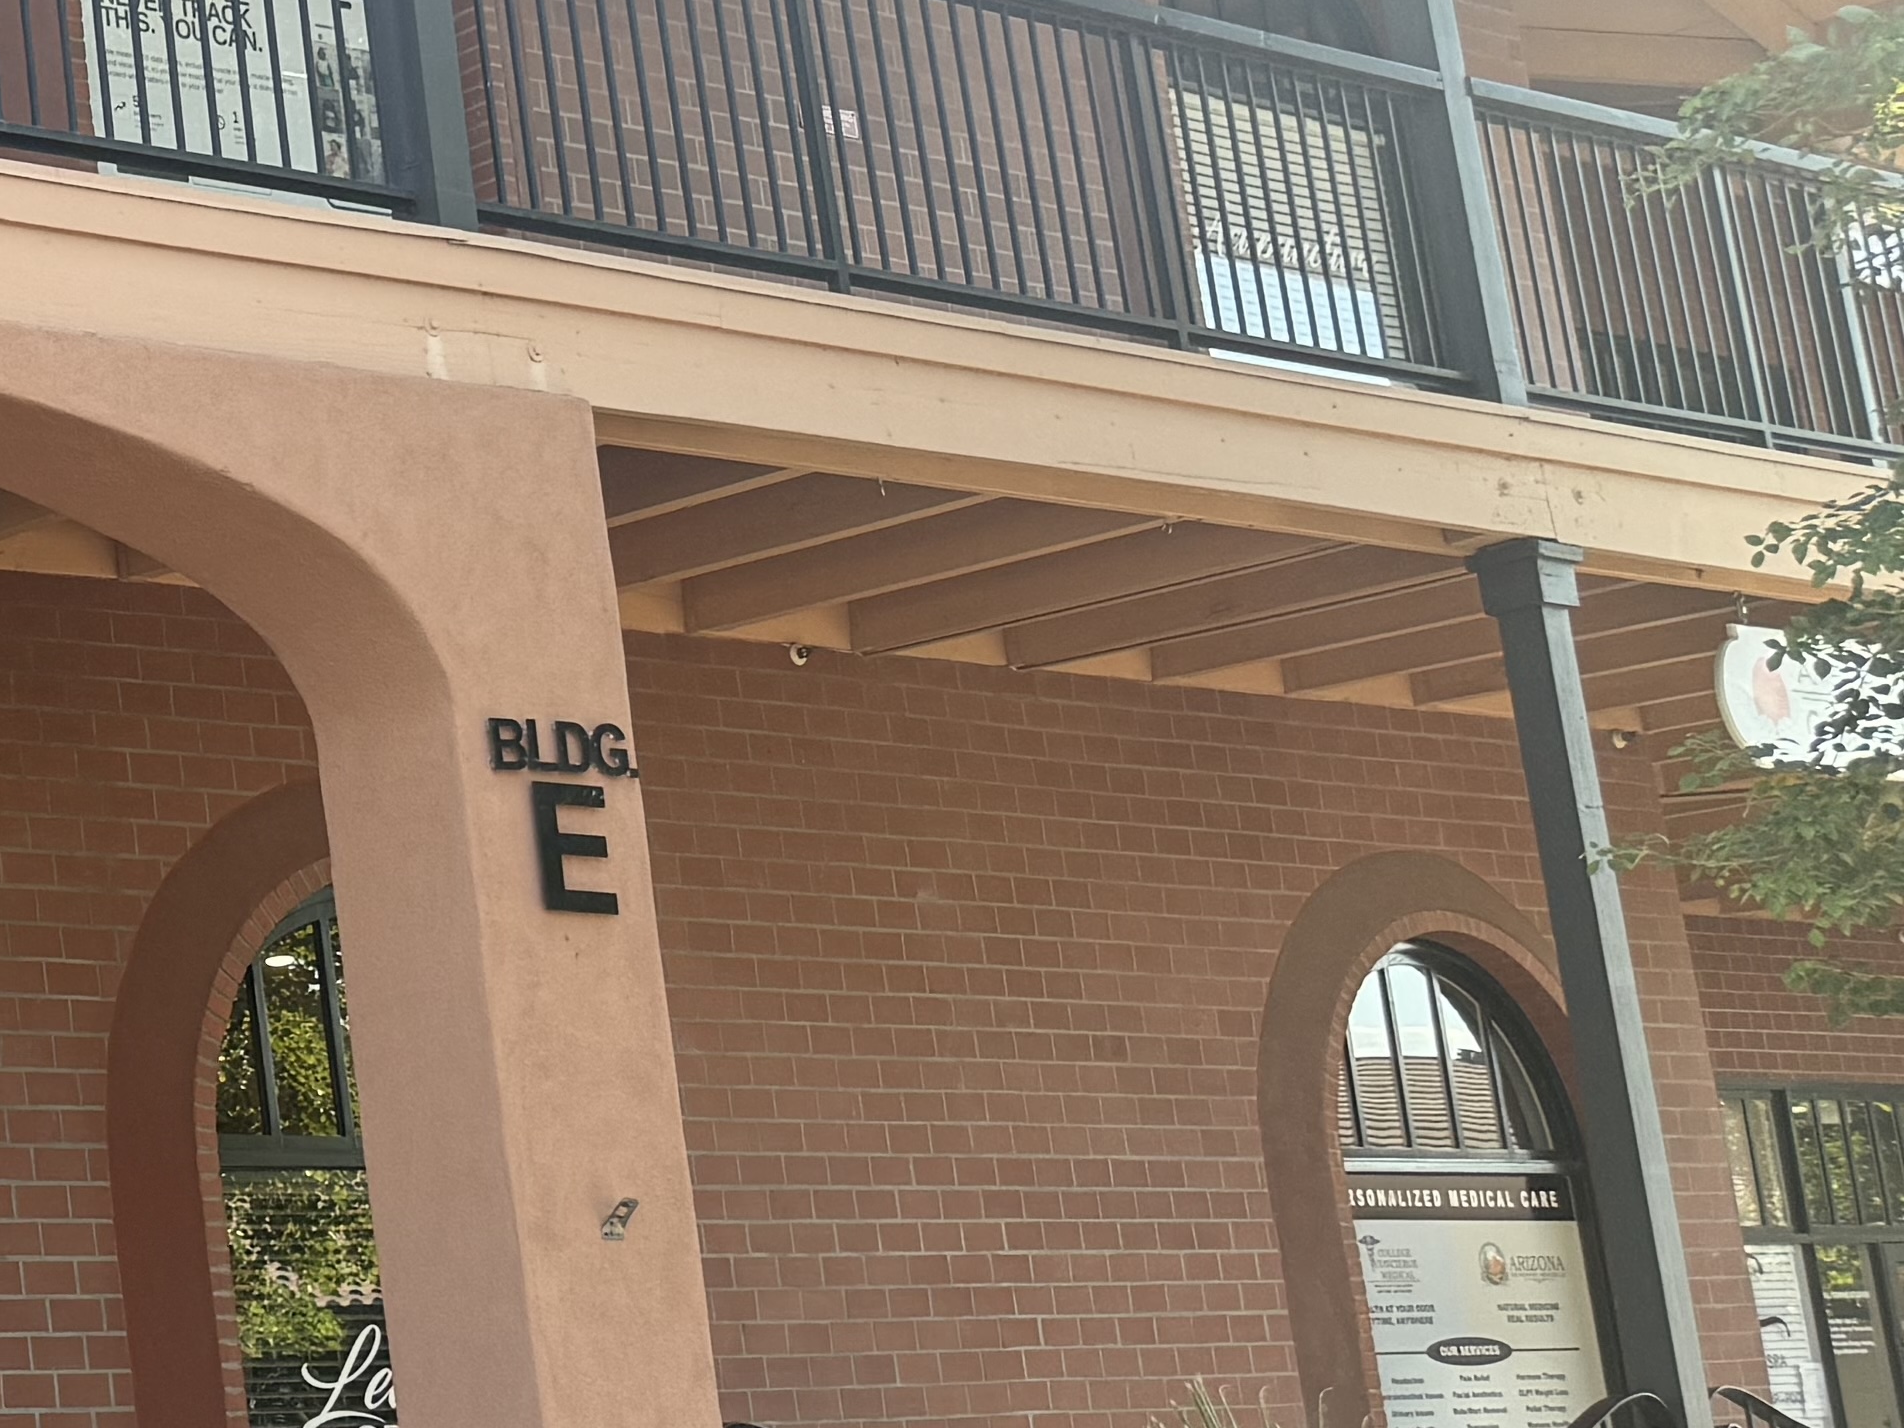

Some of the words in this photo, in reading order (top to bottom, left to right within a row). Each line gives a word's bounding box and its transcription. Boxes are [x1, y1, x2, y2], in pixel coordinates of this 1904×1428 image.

[101, 5, 155, 34] THS.
[160, 15, 202, 42] OU
[531, 781, 619, 915] E
[1448, 1189, 1514, 1207] MEDICAL
[1520, 1190, 1558, 1208] CARE
[1509, 1256, 1565, 1272] ARIZONA
